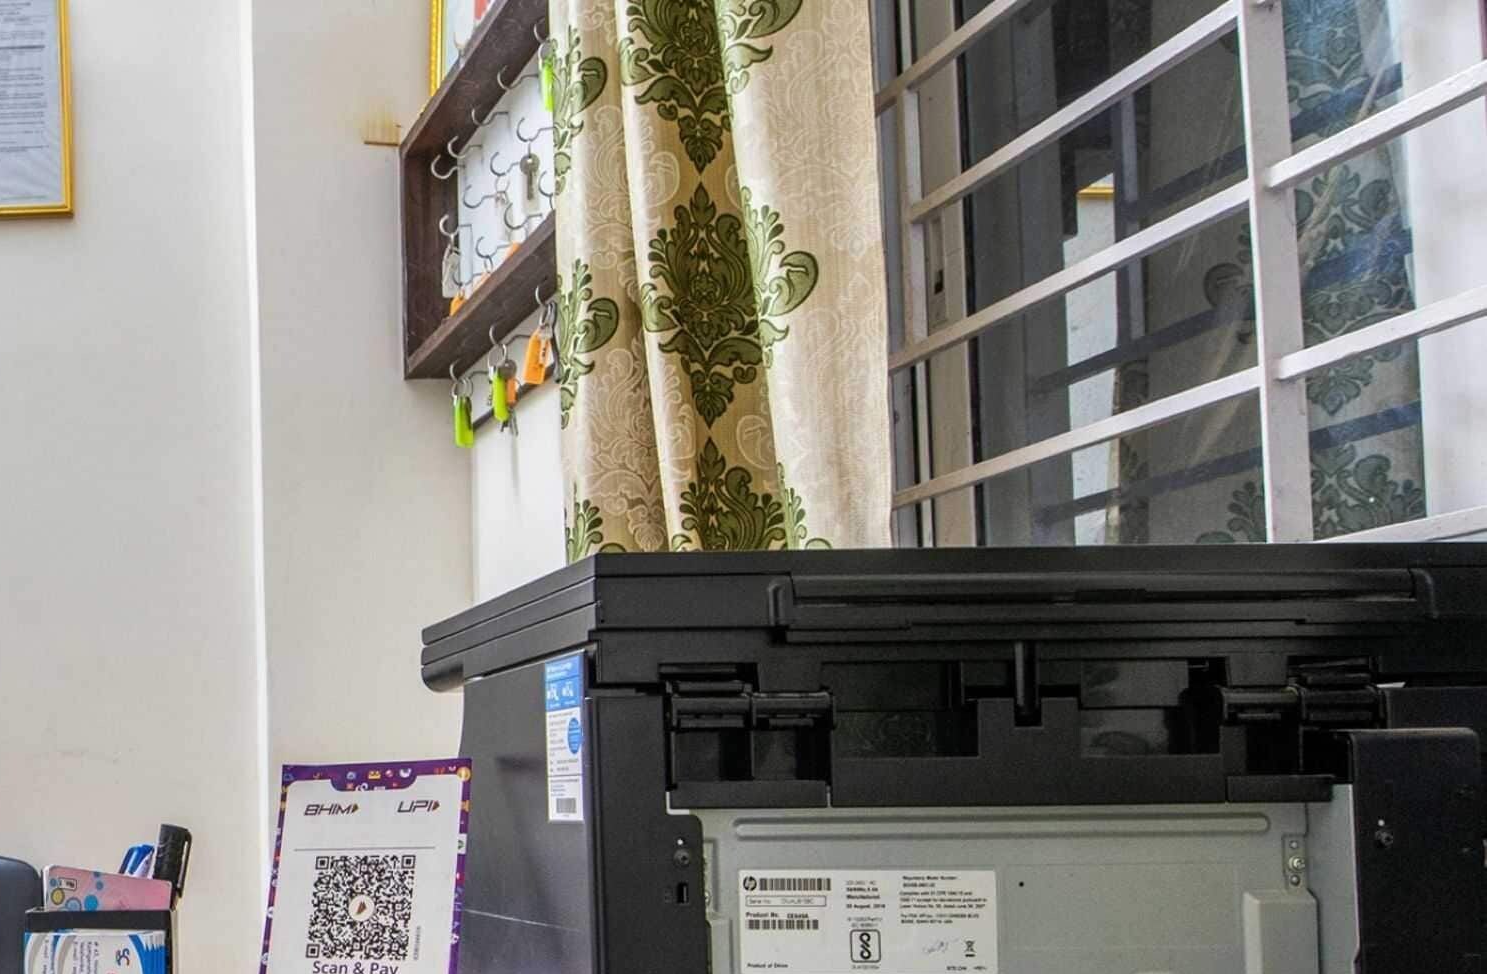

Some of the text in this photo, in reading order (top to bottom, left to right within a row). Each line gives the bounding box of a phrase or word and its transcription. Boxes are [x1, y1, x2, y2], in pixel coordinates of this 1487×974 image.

[304, 803, 353, 816] BHIM
[397, 800, 433, 813] UPI
[312, 960, 348, 974] Scan
